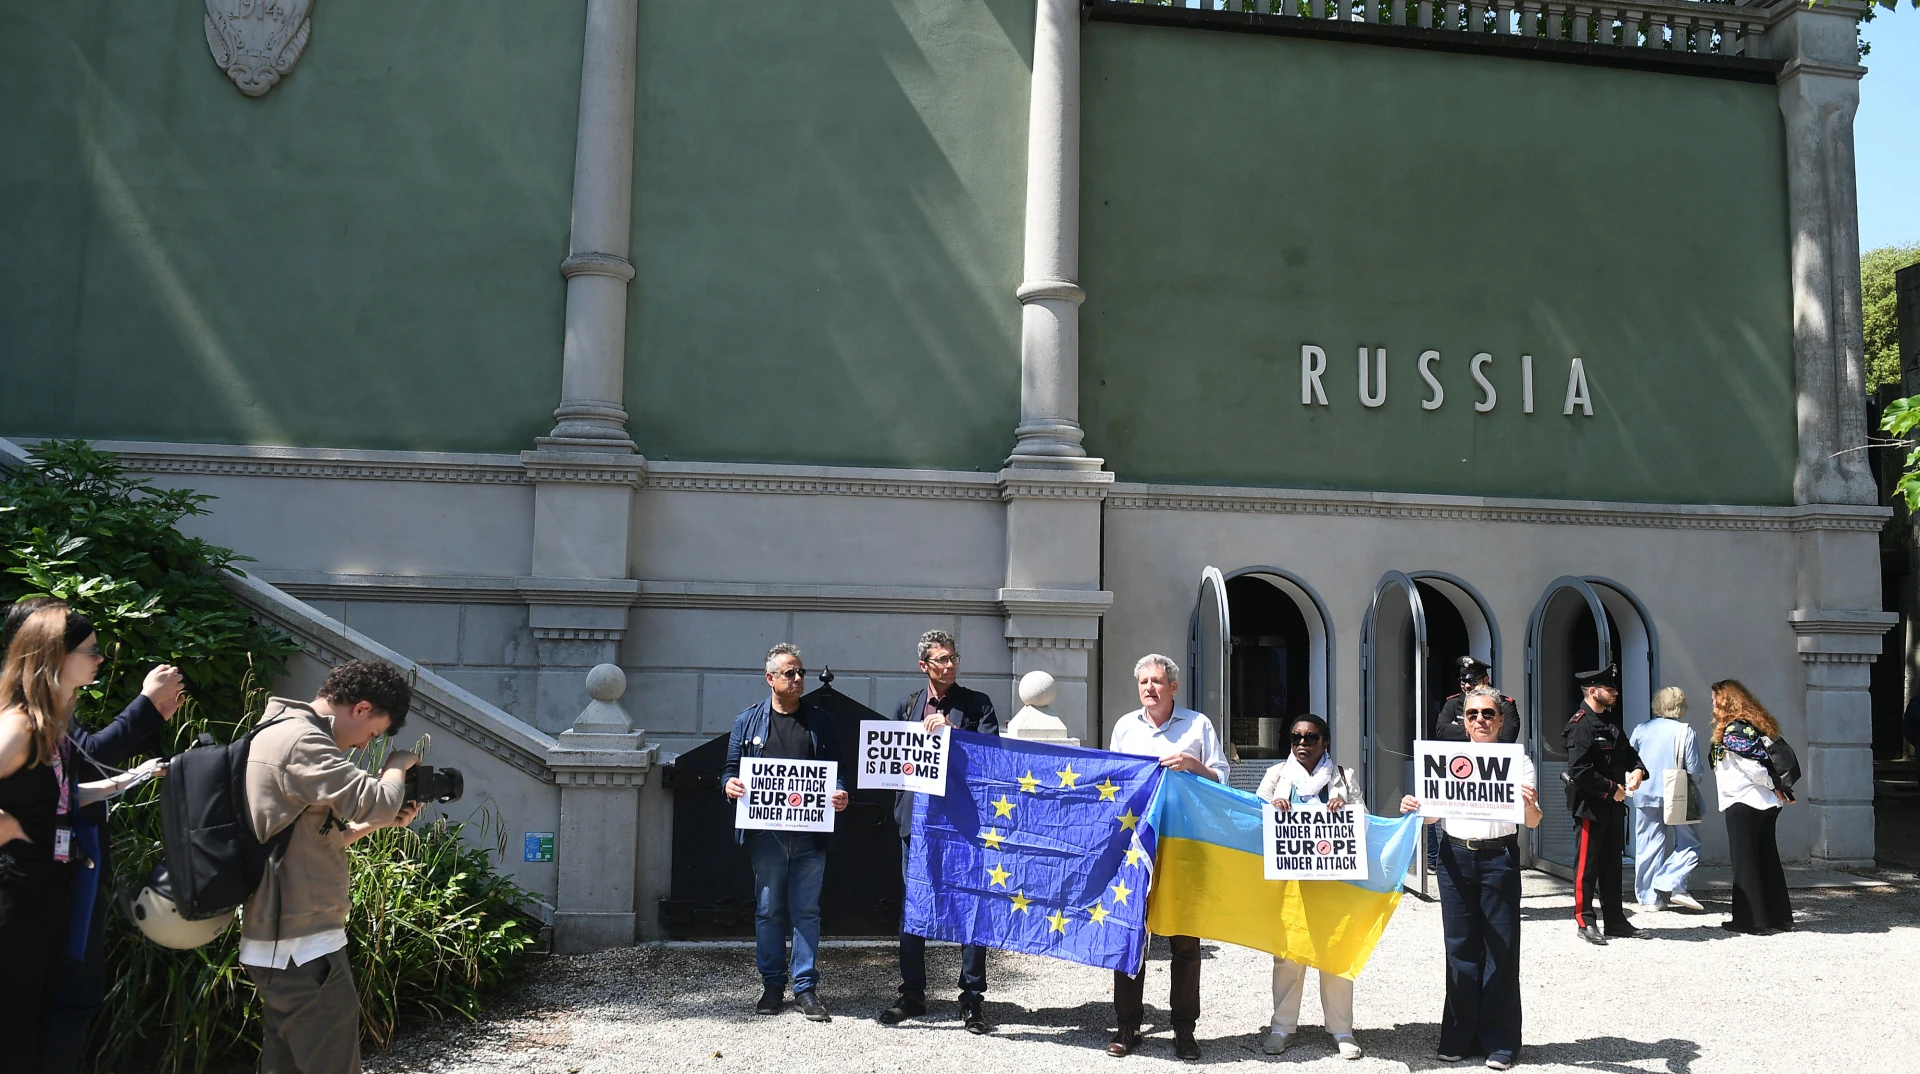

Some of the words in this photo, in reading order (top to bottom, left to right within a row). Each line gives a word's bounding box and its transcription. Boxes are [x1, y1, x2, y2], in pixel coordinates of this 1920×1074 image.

[1302, 344, 1594, 416] RUSSIA
[867, 731, 942, 750] PUTIN'S
[867, 746, 941, 765] CULTURE
[752, 763, 827, 779] UKRAINE
[866, 761, 876, 774] IS
[879, 761, 886, 774] A
[890, 761, 939, 780] BOMB
[1424, 754, 1511, 781] NOW
[751, 777, 785, 791] UNDER
[787, 778, 826, 793] ATTACK
[1424, 779, 1439, 799] IN
[1445, 780, 1515, 803] UKRAINE
[749, 790, 826, 808] EUROPE
[748, 806, 783, 820] UNDER
[786, 808, 824, 823] ATTACK
[1274, 810, 1354, 824] UKRAINE
[1275, 825, 1311, 839] UNDER
[1315, 824, 1355, 839] ATTACK
[1275, 839, 1357, 855] EUROPE
[1276, 856, 1312, 870] UNDER
[1316, 856, 1357, 870] ATTACK
